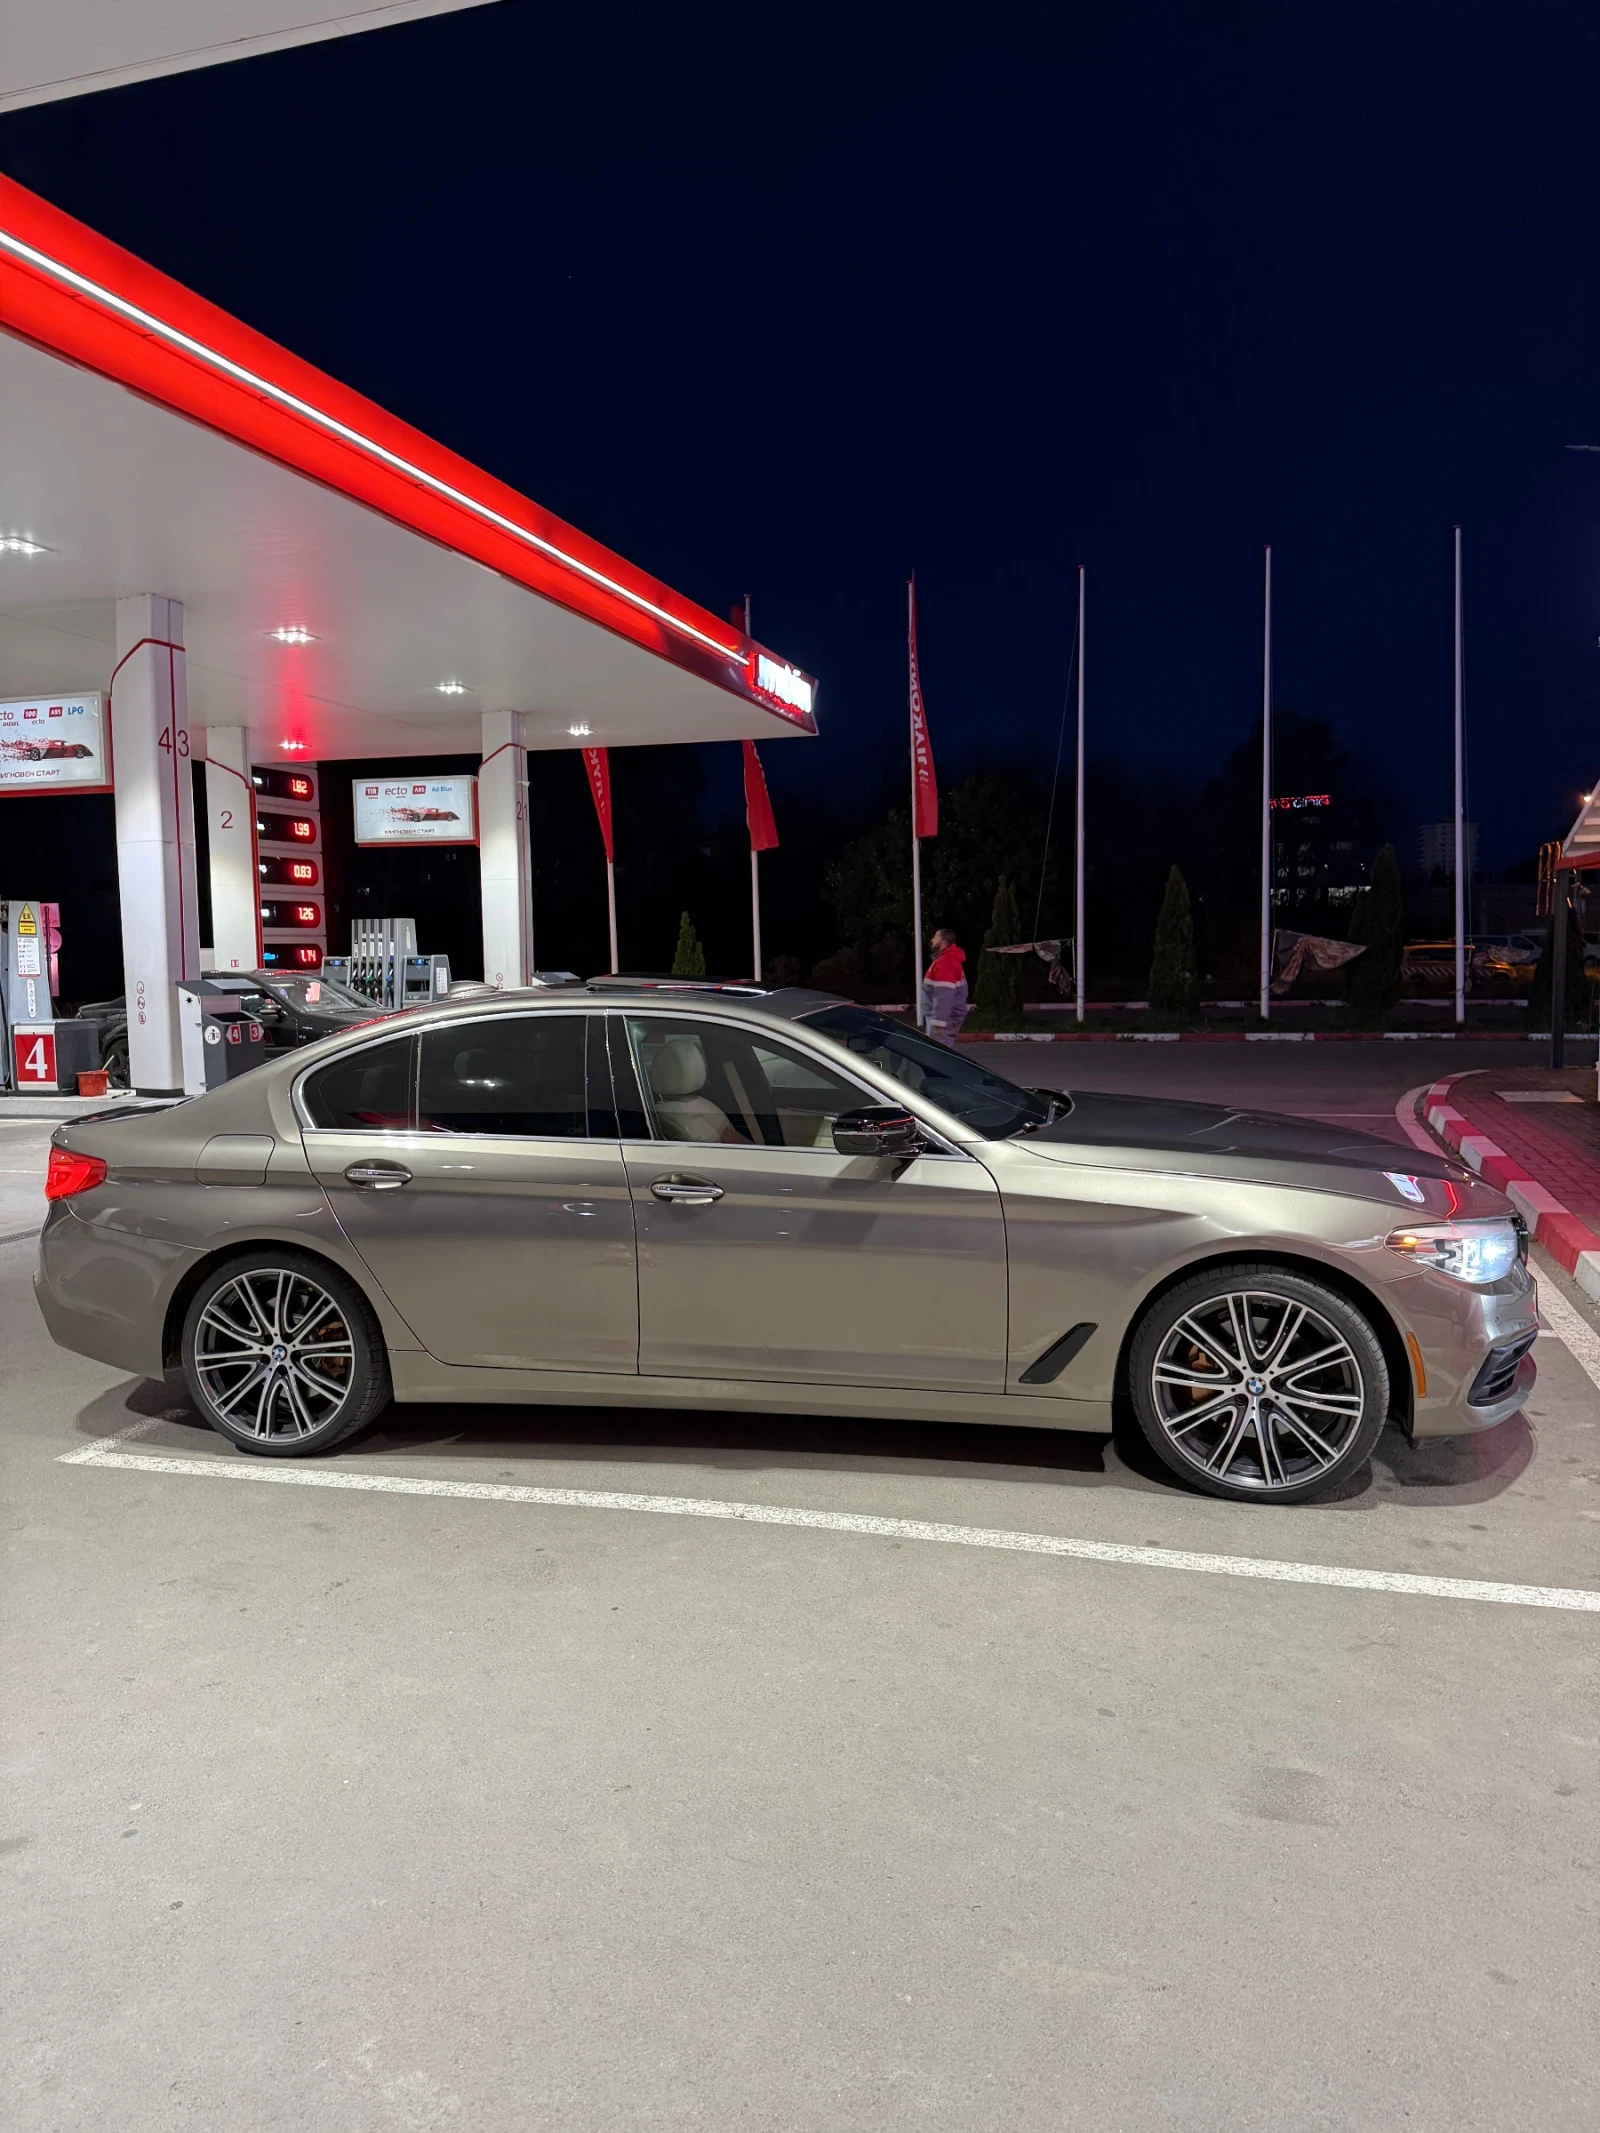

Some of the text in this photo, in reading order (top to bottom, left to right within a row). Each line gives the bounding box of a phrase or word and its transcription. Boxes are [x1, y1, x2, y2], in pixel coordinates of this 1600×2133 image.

[25, 710, 37, 718] 100
[68, 706, 84, 715] LPG
[158, 726, 189, 757] 4 3
[36, 769, 60, 777] СТАРТ
[385, 786, 408, 795] ecto
[516, 801, 528, 821] 2 1
[221, 810, 233, 829] 2
[294, 822, 310, 836] 1.99
[293, 865, 312, 878] 0.83
[298, 907, 315, 920] 1.26
[232, 1028, 239, 1040] 4
[252, 1027, 258, 1038] 3
[25, 1037, 48, 1079] 4
